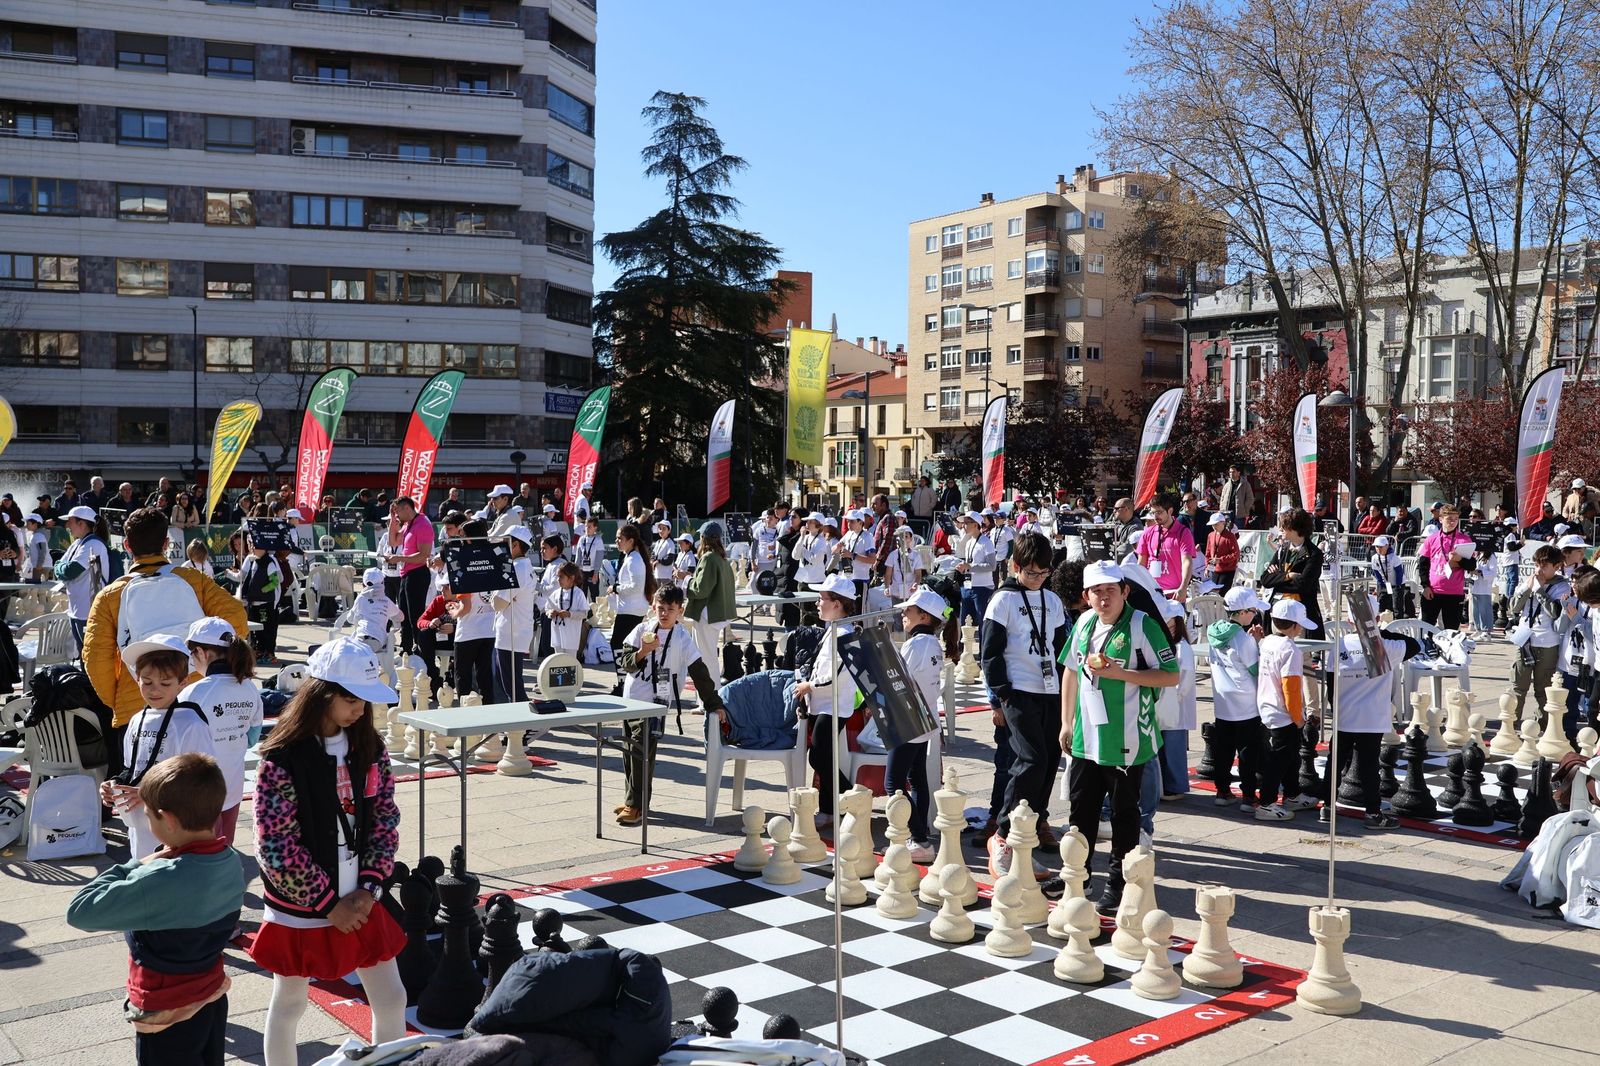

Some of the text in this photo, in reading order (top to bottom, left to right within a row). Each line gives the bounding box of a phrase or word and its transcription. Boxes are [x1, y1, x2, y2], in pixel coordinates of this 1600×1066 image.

[550, 667, 568, 675] MESA
[225, 701, 254, 709] PEQUEÑO
[646, 864, 670, 873] 3
[591, 875, 614, 883] 4
[524, 886, 550, 894] 5
[1248, 989, 1271, 999] 1
[1194, 1008, 1228, 1021] 2
[1129, 1033, 1160, 1046] 3
[1062, 1054, 1097, 1066] 4
